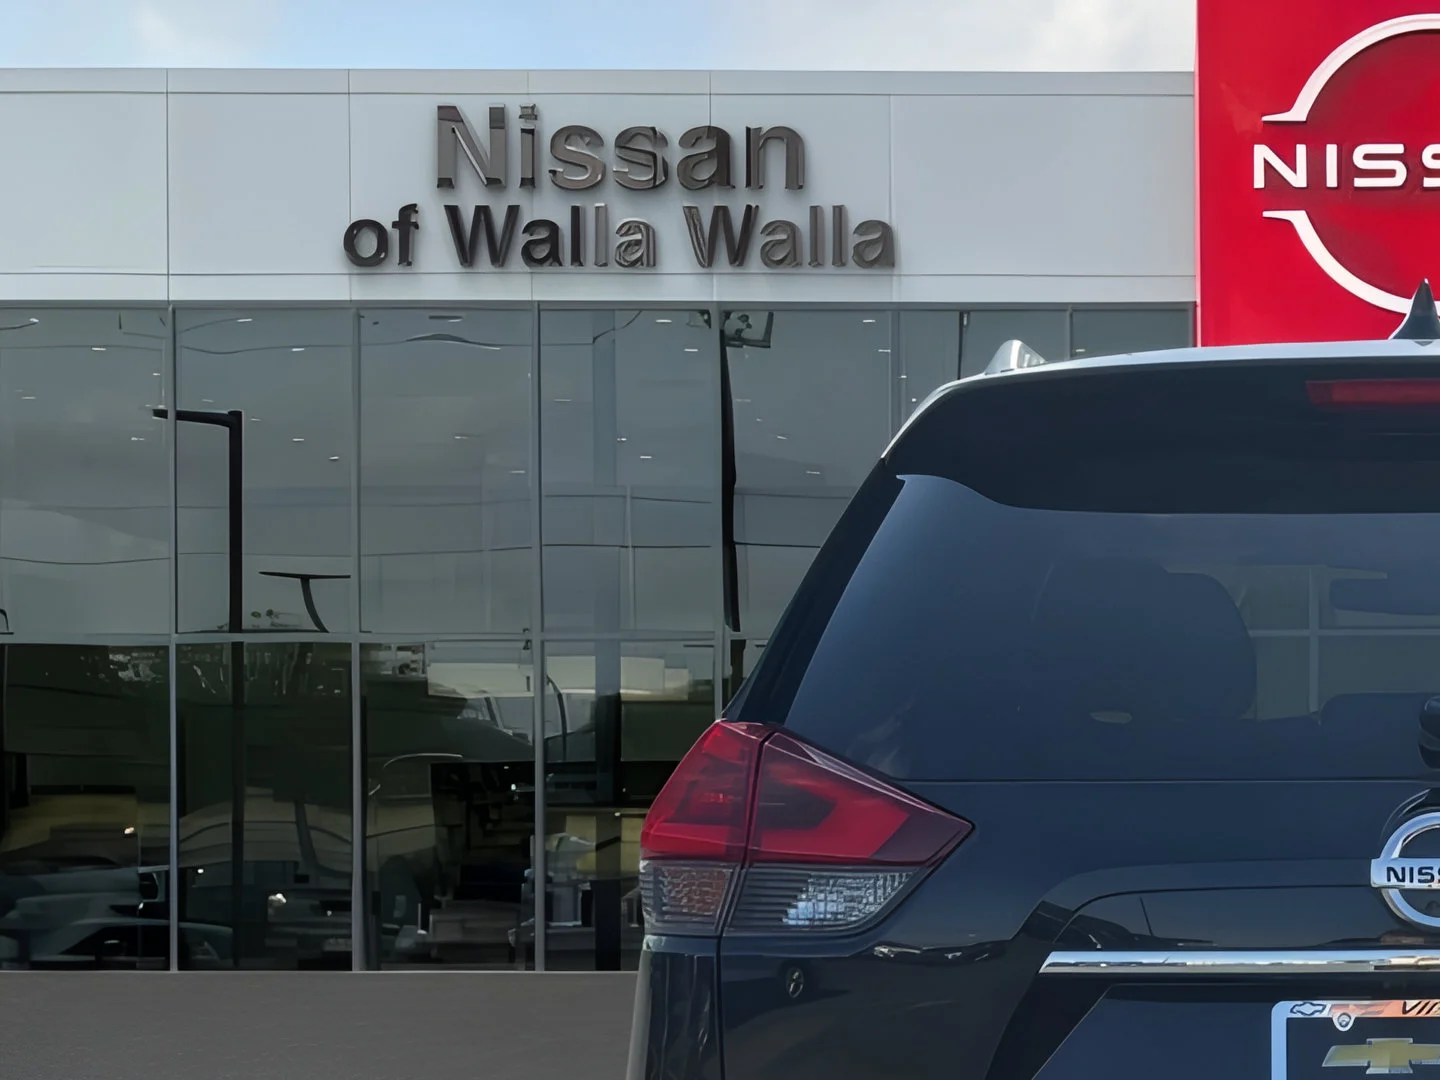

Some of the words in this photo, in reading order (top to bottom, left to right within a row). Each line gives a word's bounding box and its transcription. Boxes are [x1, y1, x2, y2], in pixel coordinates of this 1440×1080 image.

[437, 103, 805, 190] Nissan
[343, 203, 420, 268] of
[443, 203, 656, 268] Walla
[682, 203, 895, 268] Walla
